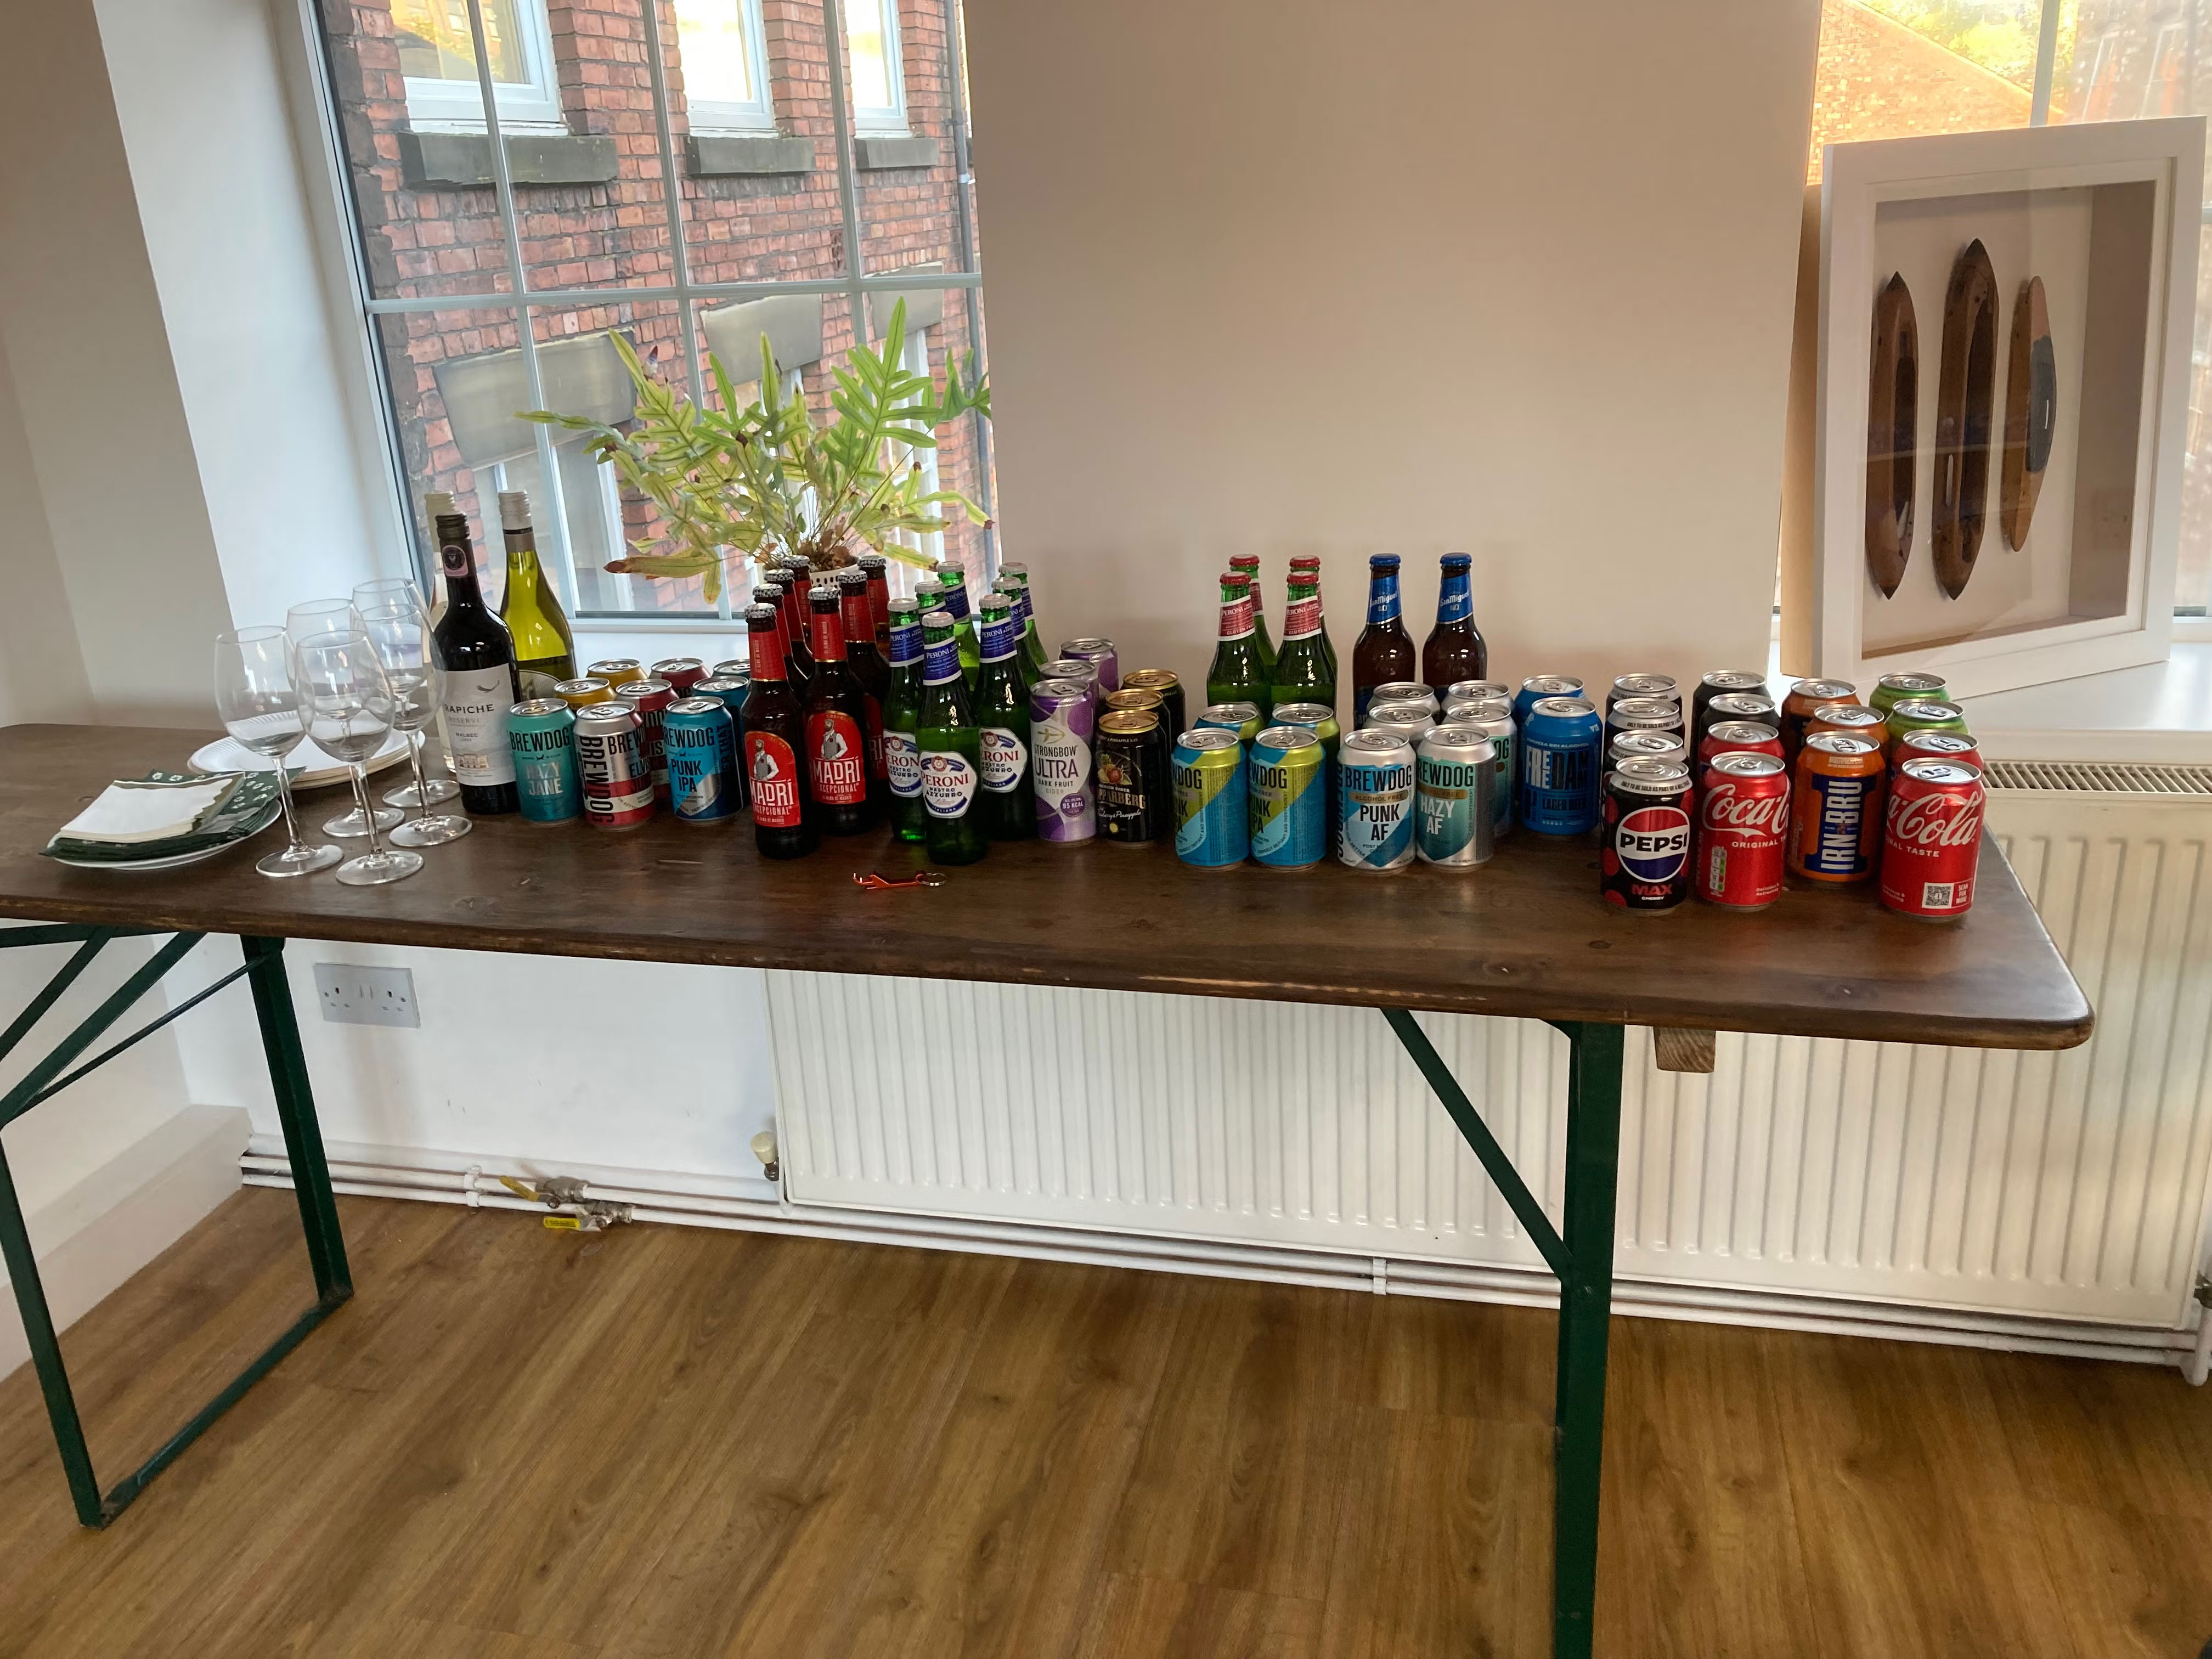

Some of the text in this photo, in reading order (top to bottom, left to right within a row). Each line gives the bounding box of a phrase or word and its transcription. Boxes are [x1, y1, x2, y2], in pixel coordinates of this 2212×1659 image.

[946, 591, 963, 601] ERONI
[1222, 607, 1244, 616] PERONI
[1286, 607, 1306, 616] PERONI
[982, 629, 1002, 639] PERONI
[927, 648, 949, 659] PERONI
[442, 704, 494, 714] RAPICHE
[509, 727, 571, 752] BREWDOG
[982, 750, 1019, 763] RONI
[1035, 745, 1076, 757] STRONGBOW
[526, 762, 560, 779] HAZY
[671, 759, 703, 776] PUNK
[1035, 758, 1079, 778] ULTRA
[579, 736, 615, 822] BREWDOG
[921, 771, 969, 787] PERONI
[1250, 763, 1288, 789] WDOG
[1345, 765, 1412, 792] BREWDOG
[529, 778, 563, 795] JANE
[679, 777, 697, 792] IPA
[1360, 803, 1400, 822] PUNK
[1421, 796, 1455, 818] HAZY
[1371, 823, 1389, 841] AF
[1426, 816, 1443, 835] AF
[1620, 831, 1688, 852] PEPSI
[1732, 839, 1778, 848] ORIGINAL
[1906, 845, 1939, 857] TASTE
[1632, 884, 1672, 895] MAX
